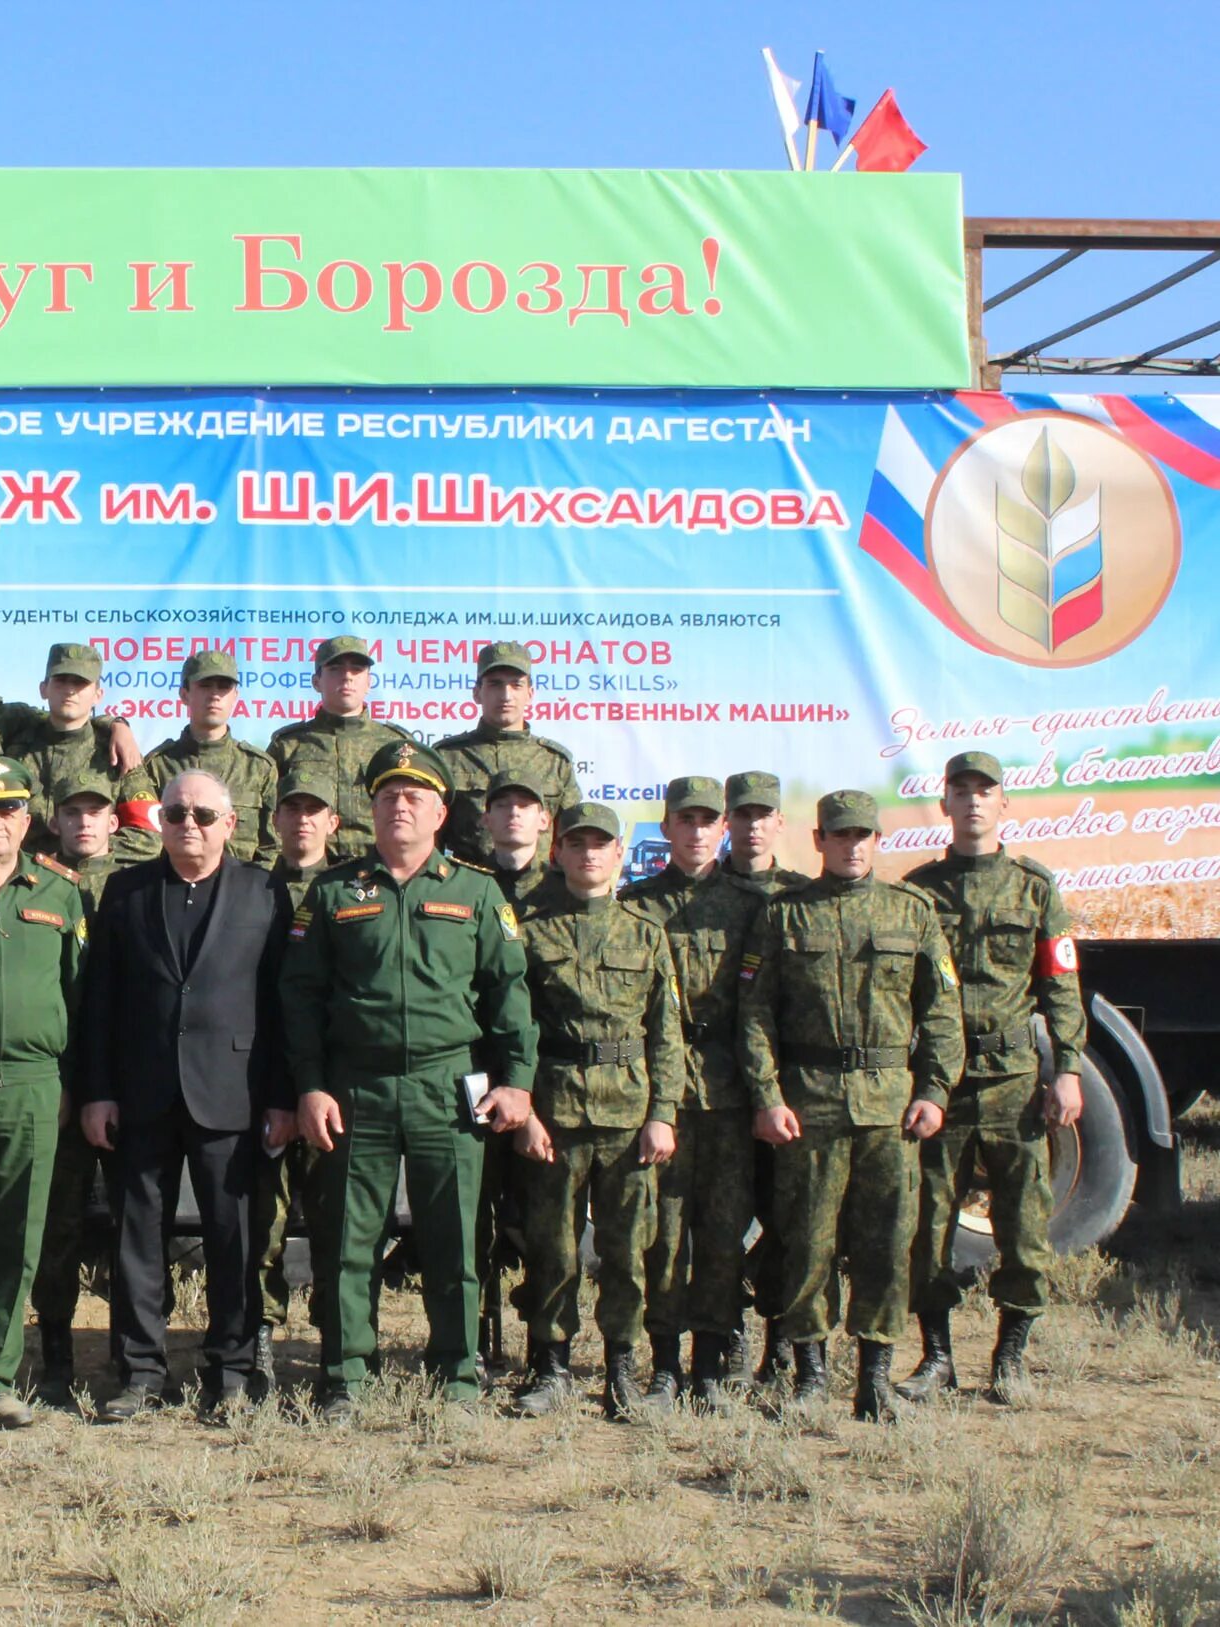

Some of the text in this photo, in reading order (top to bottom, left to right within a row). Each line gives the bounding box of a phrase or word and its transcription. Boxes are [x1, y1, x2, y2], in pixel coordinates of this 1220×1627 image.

[127, 259, 195, 315] и
[232, 231, 725, 333] Борозда!
[59, 411, 325, 441] УЧРЕЖДЕНИЕ
[337, 411, 597, 441] РЕСПУБЛИКИ
[606, 416, 812, 444] ДАГЕСТАН
[84, 606, 345, 624] СЕЛЬСКОХОЗЯЙСТВЕННОГО
[351, 610, 459, 627] КОЛЛЕДЖА
[680, 613, 781, 628] ЯВЛЯЮТСЯ
[89, 637, 672, 666] ПОБЕДИТЕЛЯИ ЧЕМПОНАТОВ
[729, 703, 851, 723] МАШИН»
